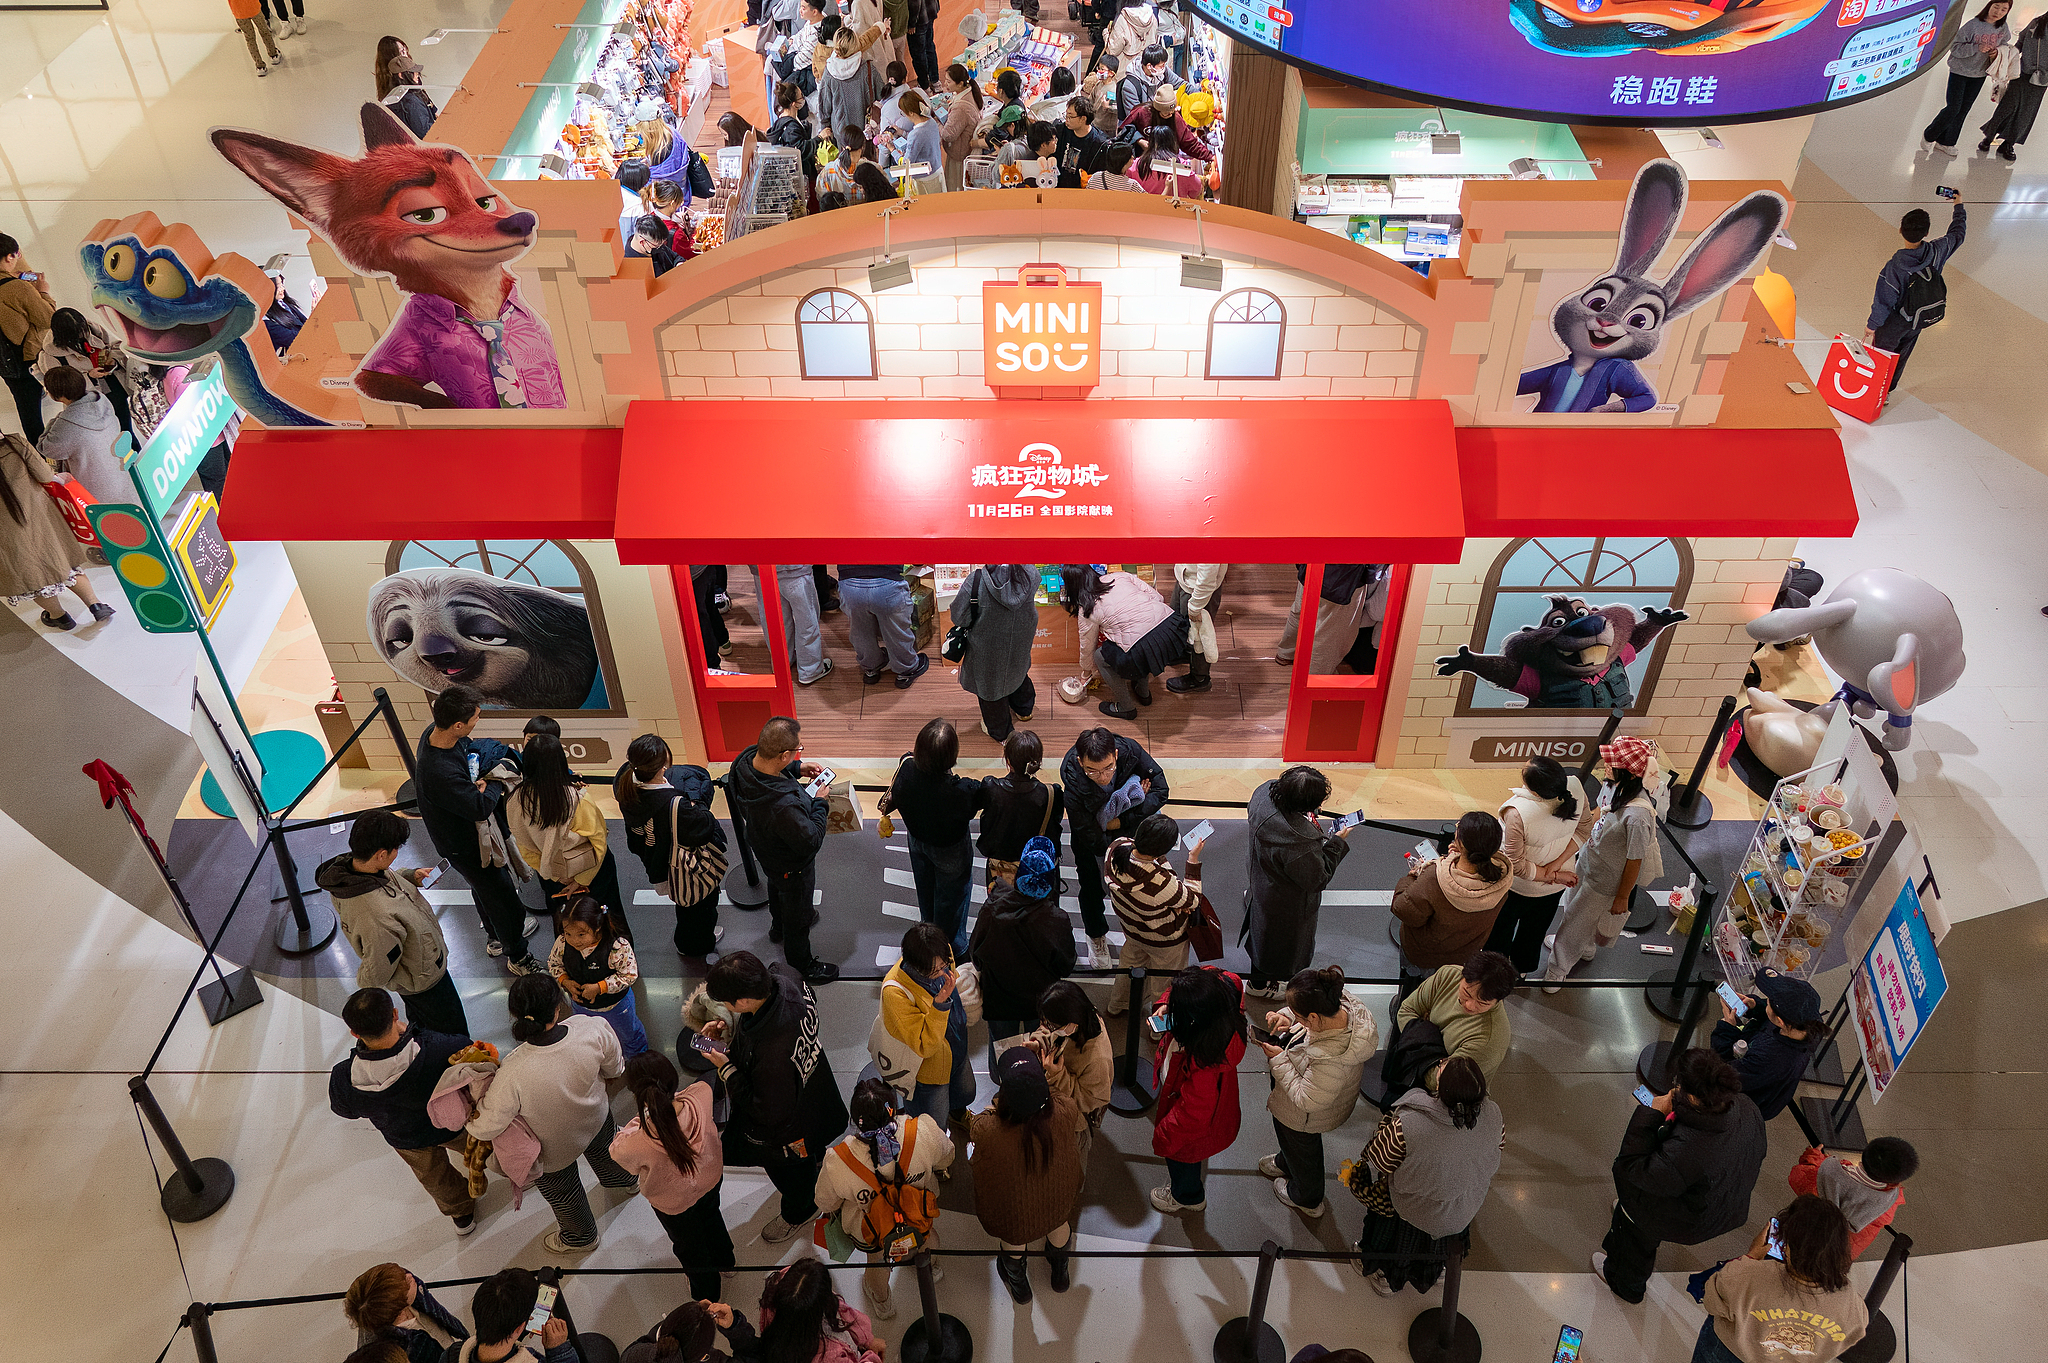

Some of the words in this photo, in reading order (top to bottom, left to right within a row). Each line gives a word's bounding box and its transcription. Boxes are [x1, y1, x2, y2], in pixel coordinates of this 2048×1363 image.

[1610, 75, 1718, 105] 稳跑鞋
[995, 302, 1089, 333] MINI
[152, 379, 229, 499] DOWNTOW
[1029, 453, 1052, 463] Disney
[971, 464, 1109, 487] 疯狂动物城
[968, 504, 1034, 517] 11月26日
[1040, 505, 1113, 516] 全国影院献映
[1494, 742, 1586, 757] MINISO
[1897, 921, 1926, 999] 限时快闪
[1876, 952, 1906, 1042] 食品、饮料入场
[1888, 959, 1907, 1011] 请勿携带
[1750, 1308, 1846, 1342] WHATEVER
